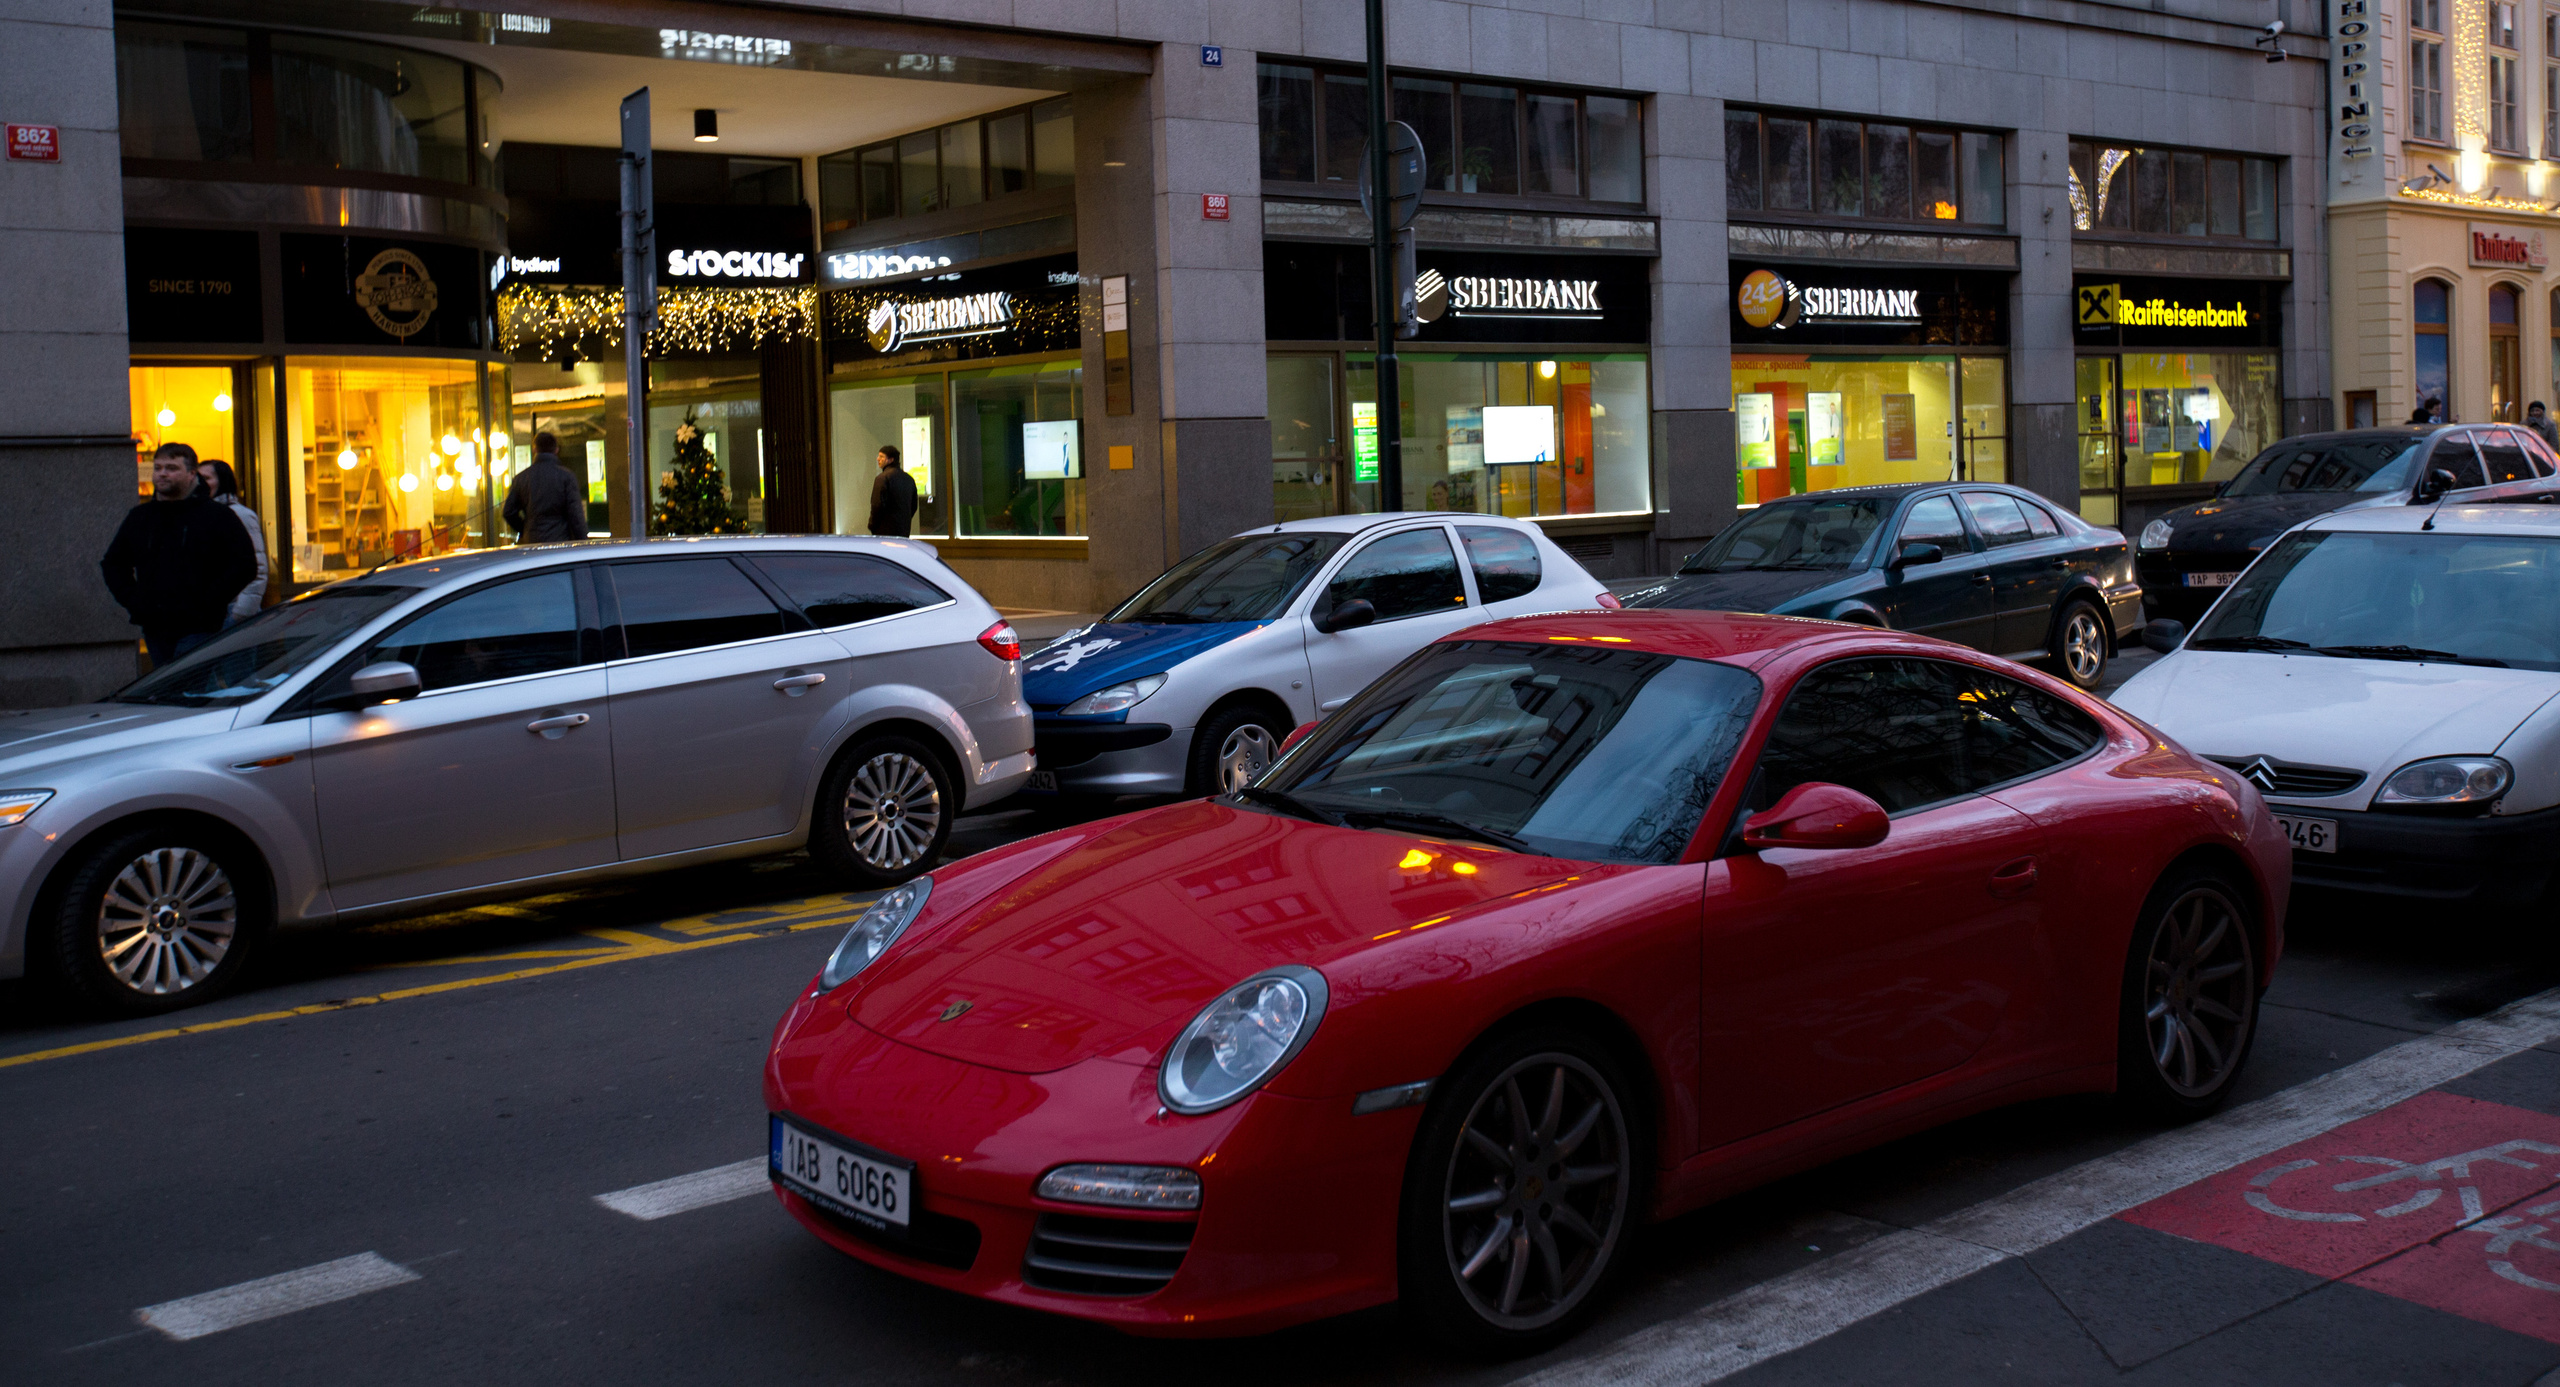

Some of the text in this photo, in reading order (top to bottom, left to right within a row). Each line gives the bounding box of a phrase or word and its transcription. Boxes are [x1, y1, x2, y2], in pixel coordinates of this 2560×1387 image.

[1206, 50, 1219, 63] 24
[17, 128, 51, 144] 862
[1208, 196, 1226, 208] 860
[2473, 231, 2529, 263] Emirates
[668, 249, 804, 278] STOCKIST
[149, 279, 232, 295] SINCE 1790
[1454, 276, 1602, 310] SBERBANK
[1742, 282, 1765, 306] 24
[900, 291, 1007, 335] SBERBANK
[1742, 306, 1767, 316] hodin
[1804, 287, 1921, 317] SBERBANK
[2121, 299, 2247, 327] Raiffeisenbank
[2191, 574, 2208, 585] 1AP
[789, 1133, 897, 1213] 1AB 6066
[783, 1178, 816, 1203] PORSCHE
[816, 1195, 855, 1217] CENTRUM
